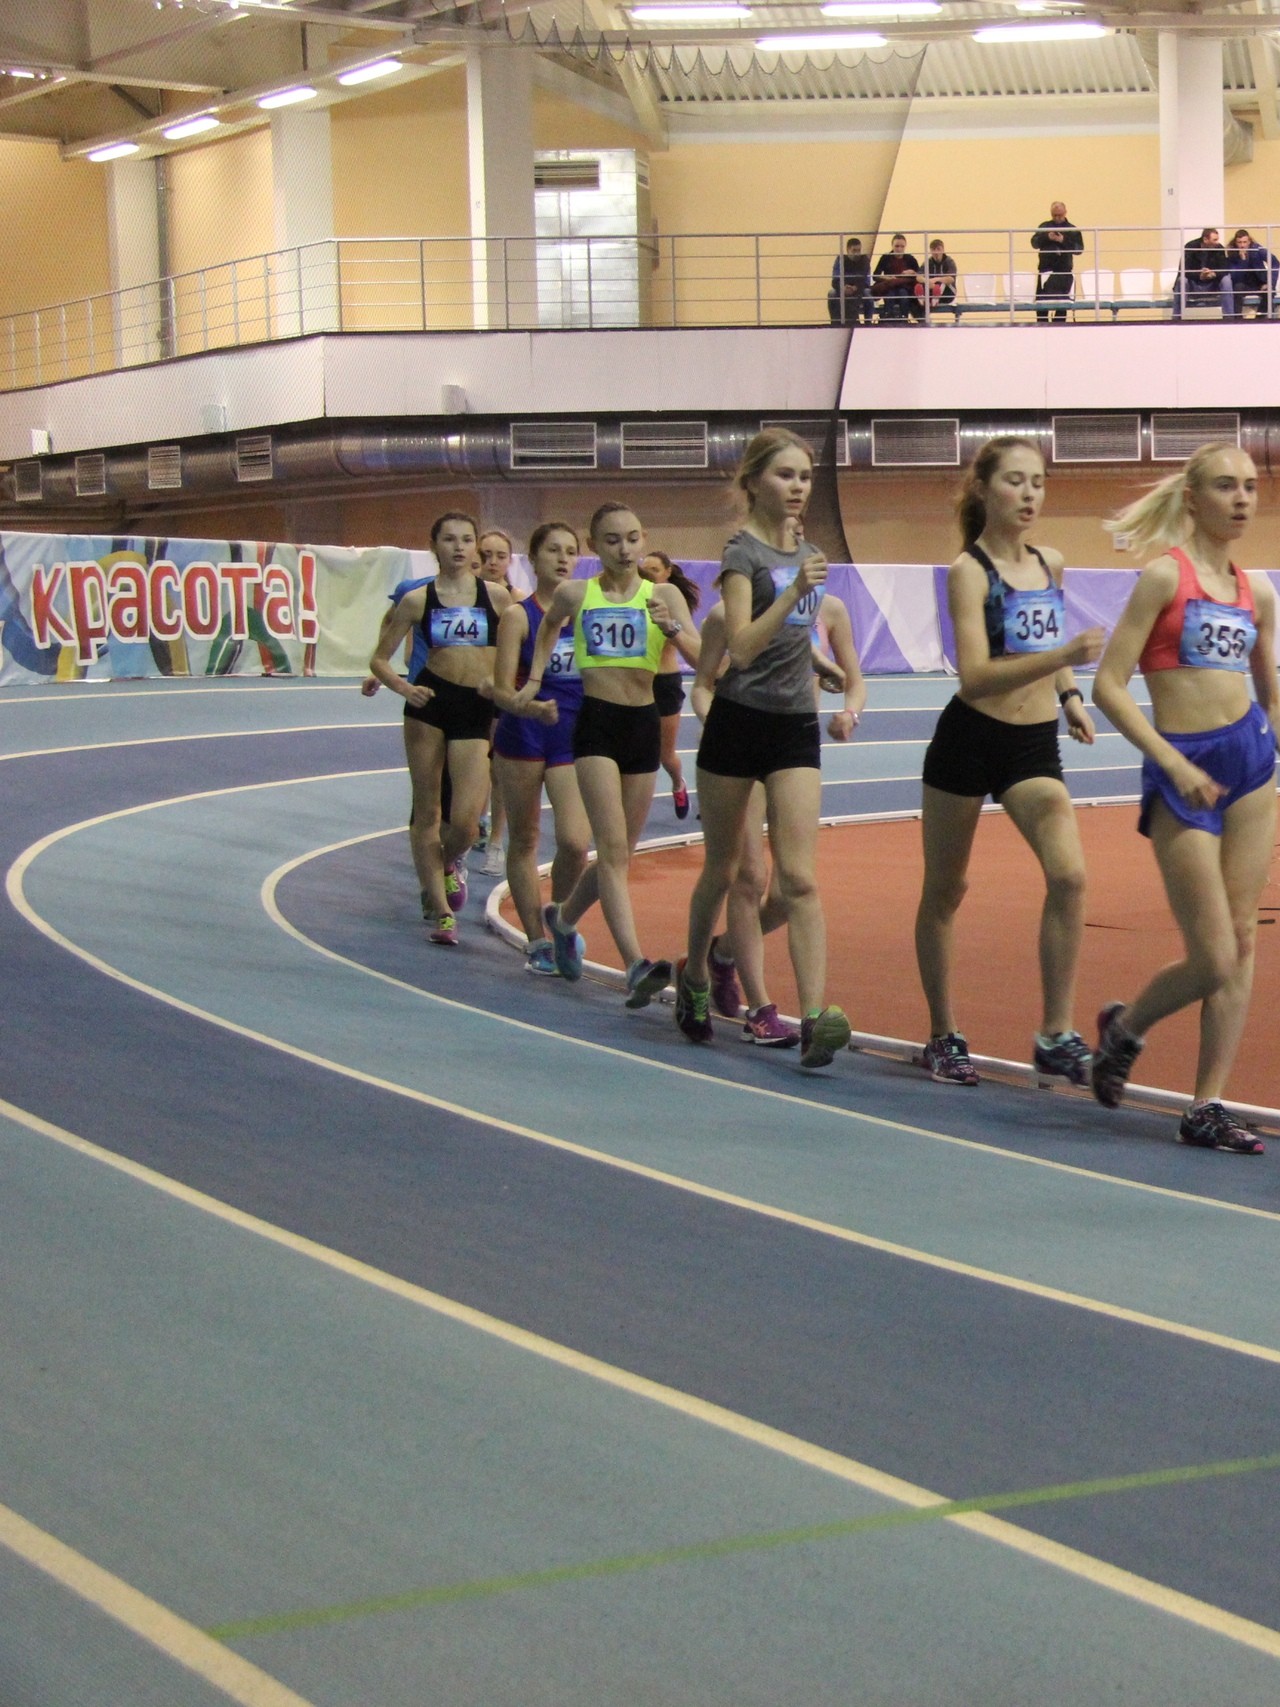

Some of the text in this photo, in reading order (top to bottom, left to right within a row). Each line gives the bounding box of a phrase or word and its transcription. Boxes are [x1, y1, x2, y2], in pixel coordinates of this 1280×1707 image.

[32, 552, 318, 664] красота!
[440, 619, 480, 640] 744
[591, 622, 635, 649] 310
[1016, 608, 1059, 641] 354
[1197, 622, 1247, 659] 356
[550, 651, 576, 674] 87
